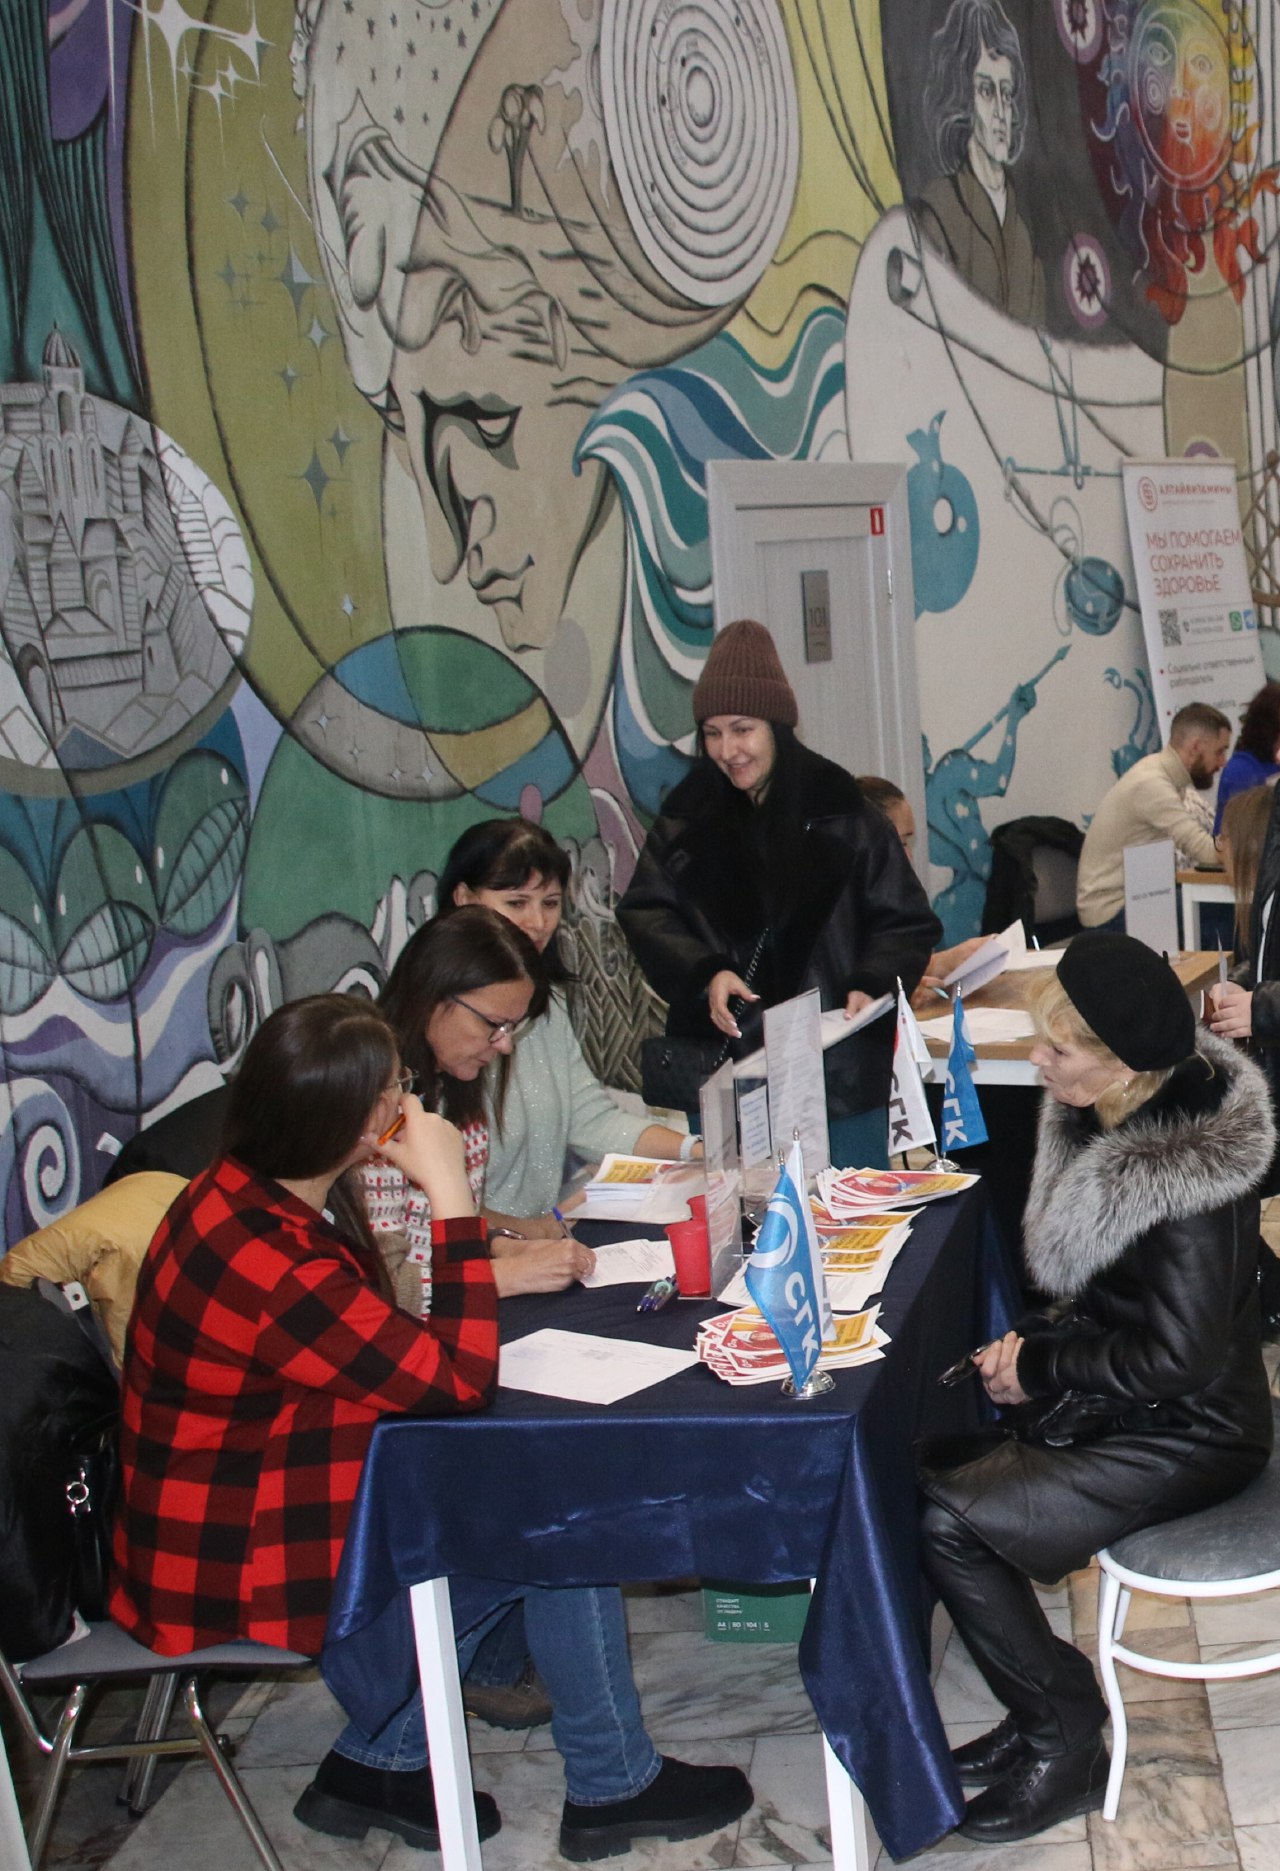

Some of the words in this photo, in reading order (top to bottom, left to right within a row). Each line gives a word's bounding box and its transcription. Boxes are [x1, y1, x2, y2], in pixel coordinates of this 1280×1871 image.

[1147, 533, 1168, 549] МЫ
[1170, 528, 1241, 549] ПОМОГАЕМ
[1150, 552, 1224, 573] СОХРАНИТЬ
[1153, 575, 1221, 597] ЗДОРОВЬЕ
[784, 1271, 819, 1370] СГК
